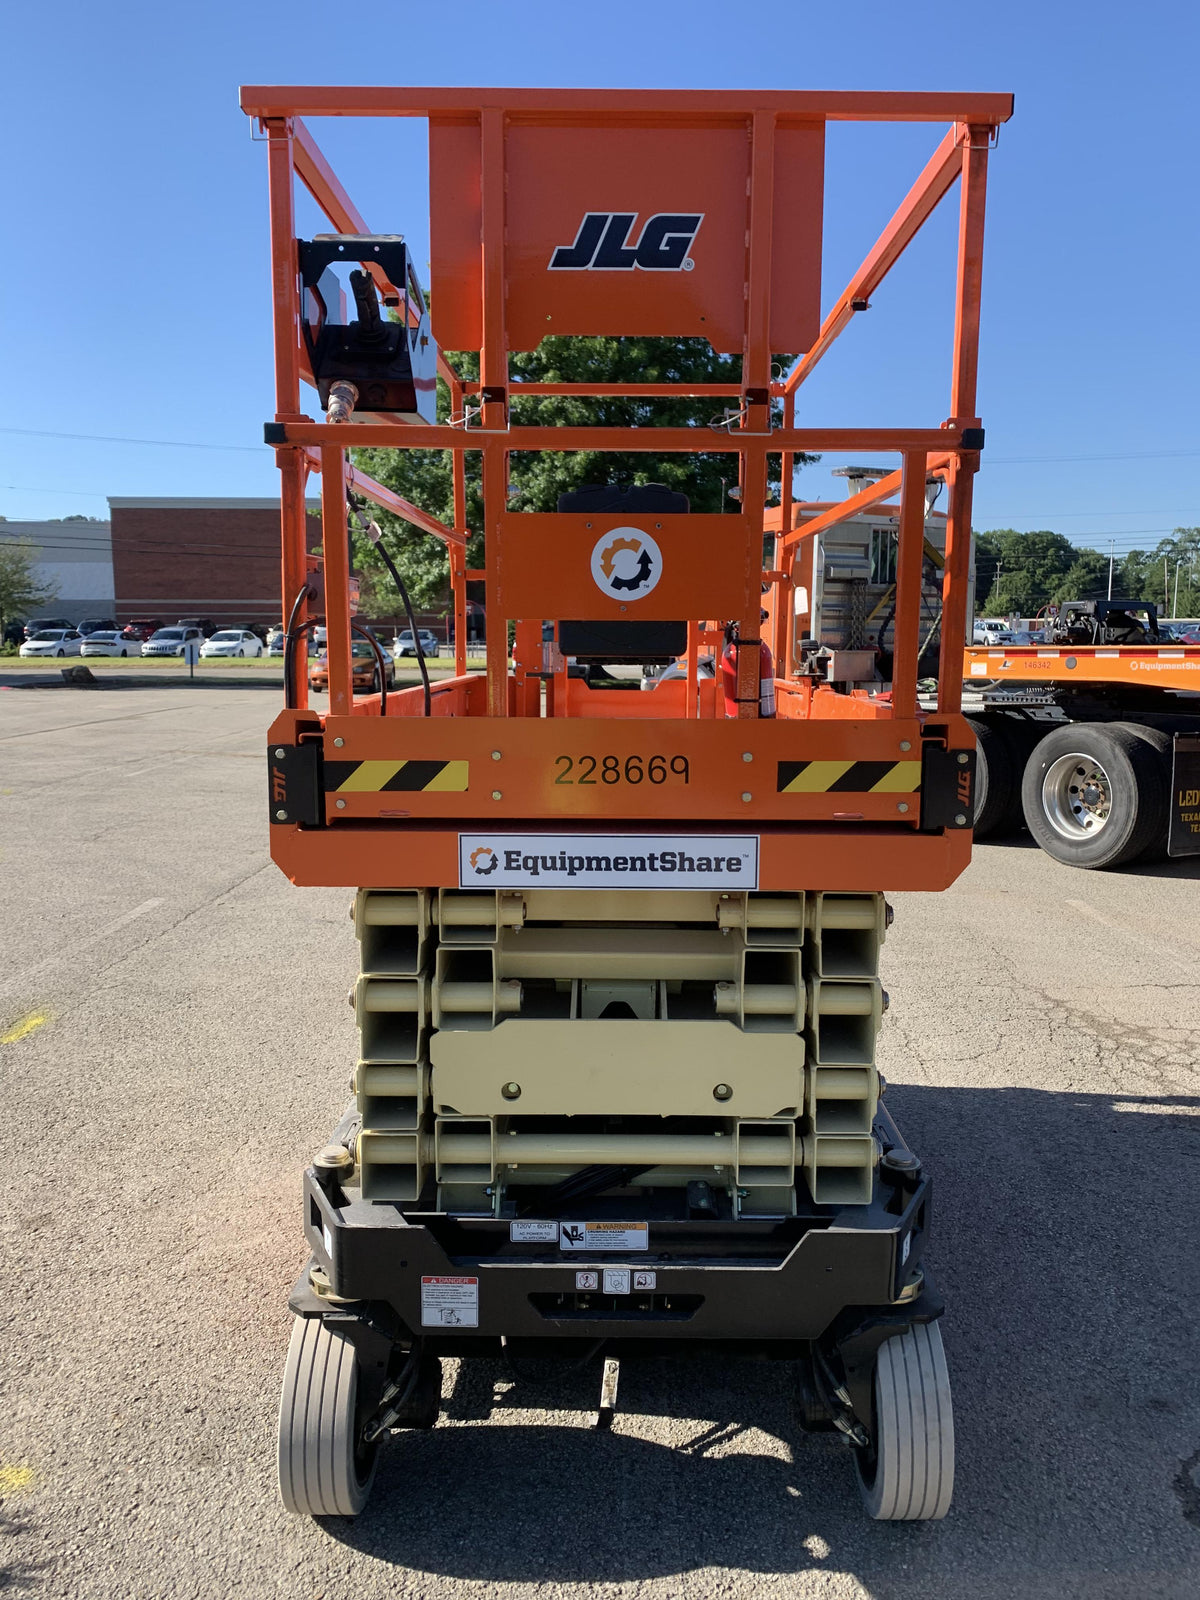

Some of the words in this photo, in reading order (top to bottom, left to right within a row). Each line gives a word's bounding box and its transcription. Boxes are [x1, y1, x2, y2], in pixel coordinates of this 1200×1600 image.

[547, 212, 705, 271] JLG
[1024, 661, 1051, 669] 146342
[554, 755, 690, 785] 228669
[272, 766, 287, 803] JLG
[957, 770, 971, 808] JLG
[1179, 790, 1200, 807] LED
[1181, 812, 1200, 822] TEXA
[503, 850, 743, 876] EquipmentShare
